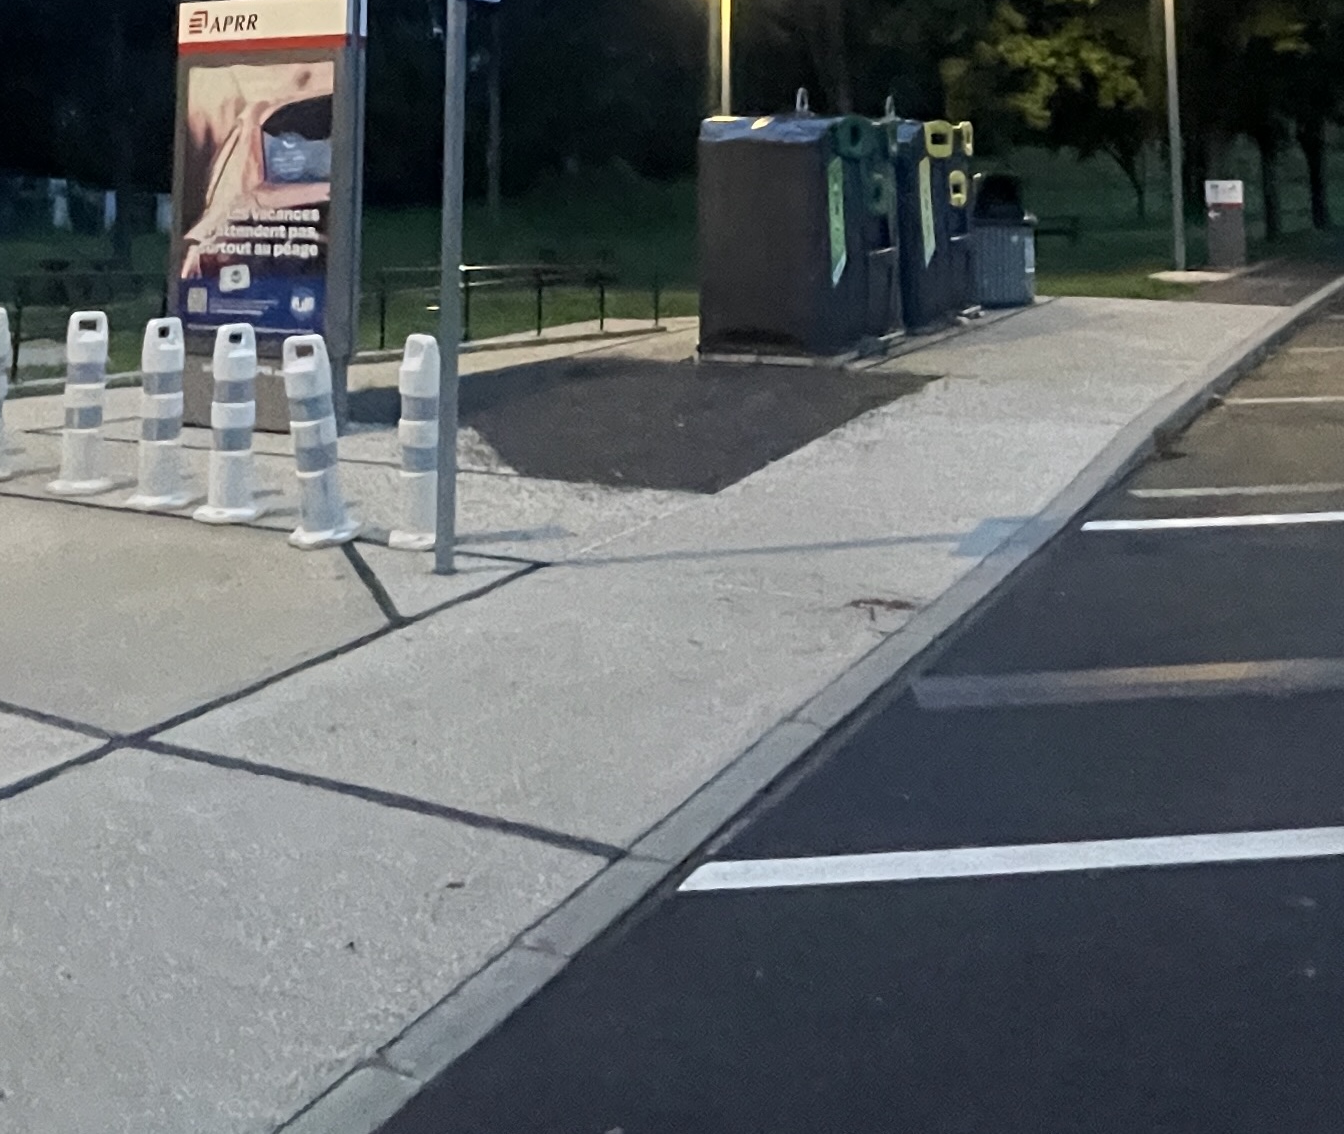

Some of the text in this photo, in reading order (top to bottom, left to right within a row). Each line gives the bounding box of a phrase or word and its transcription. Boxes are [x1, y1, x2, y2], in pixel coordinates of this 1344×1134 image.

[209, 14, 258, 34] APRR
[251, 208, 320, 222] vacances
[254, 244, 271, 256] au
[273, 240, 319, 258] péage
